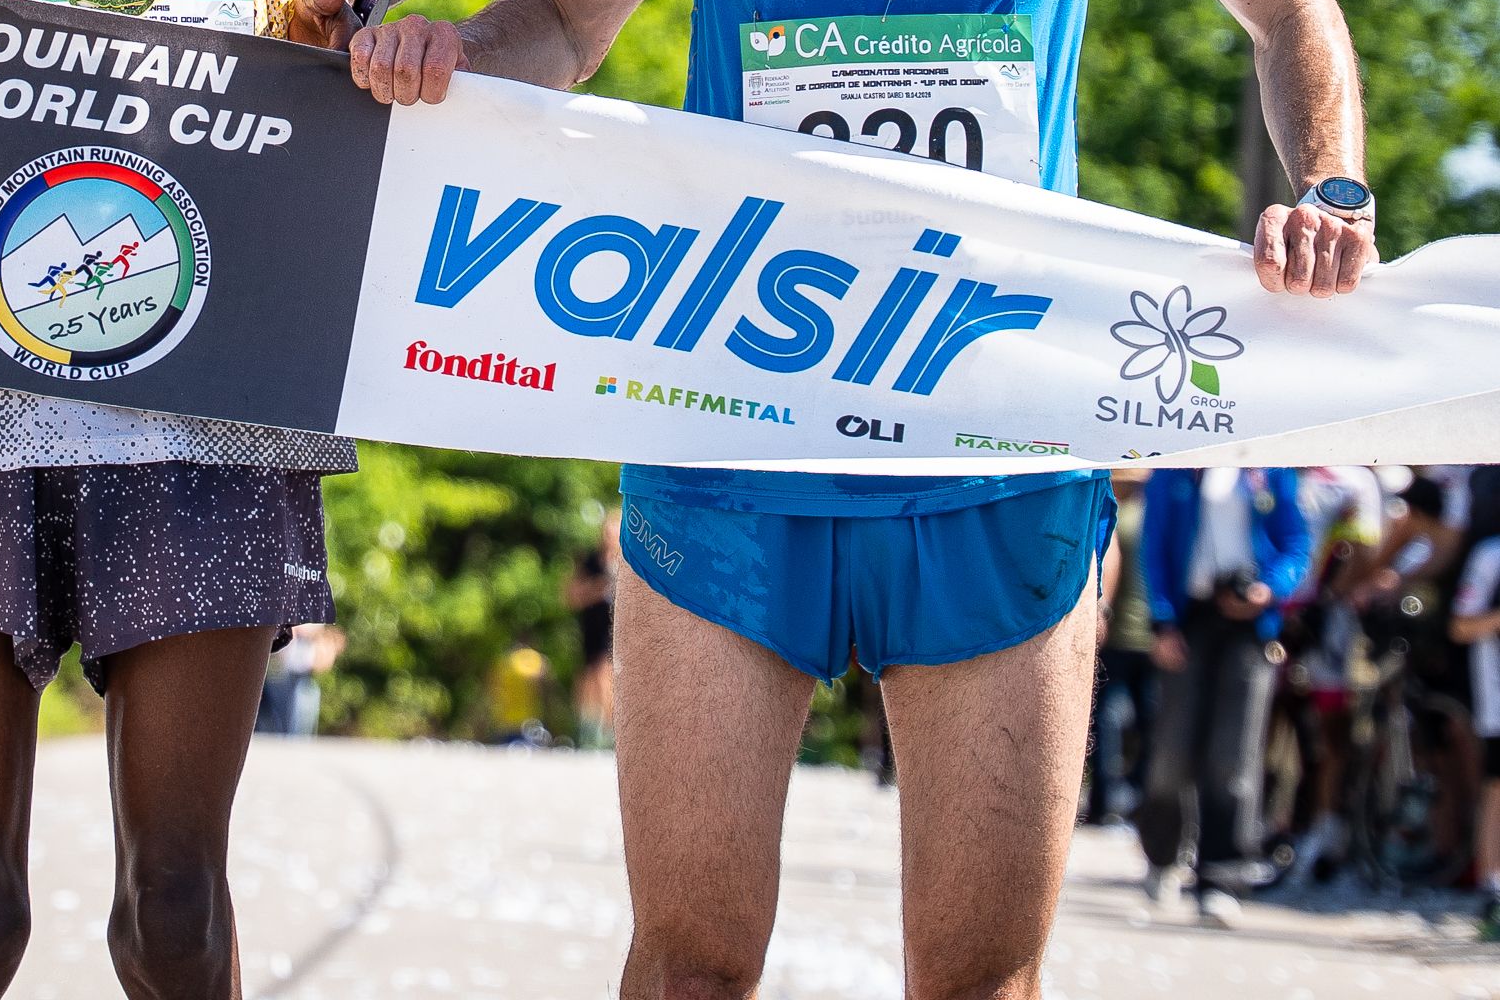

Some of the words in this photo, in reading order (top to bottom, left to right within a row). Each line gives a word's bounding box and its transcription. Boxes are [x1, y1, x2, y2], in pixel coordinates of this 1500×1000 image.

[794, 21, 848, 58] CA
[854, 34, 932, 55] Crédito
[938, 34, 1022, 57] Agrícola
[796, 83, 807, 91] DE
[809, 81, 846, 90] CORRIDA
[169, 103, 292, 155] CUP
[1, 148, 85, 196] MOUNTAIN
[90, 148, 165, 183] RUNNING
[163, 180, 211, 287] ASSOCIATION
[414, 184, 1054, 397] valsir
[48, 314, 85, 340] 25
[87, 296, 158, 336] Years
[12, 346, 82, 381] WORLD
[89, 362, 131, 381] CUP
[403, 340, 559, 392] fondital
[626, 379, 796, 427] RAFFMETAL
[1095, 396, 1234, 434] SILMAR
[1190, 395, 1236, 410] GROUP
[836, 414, 905, 443] OLI
[954, 436, 1070, 455] MARVON
[626, 504, 684, 576] OMM
